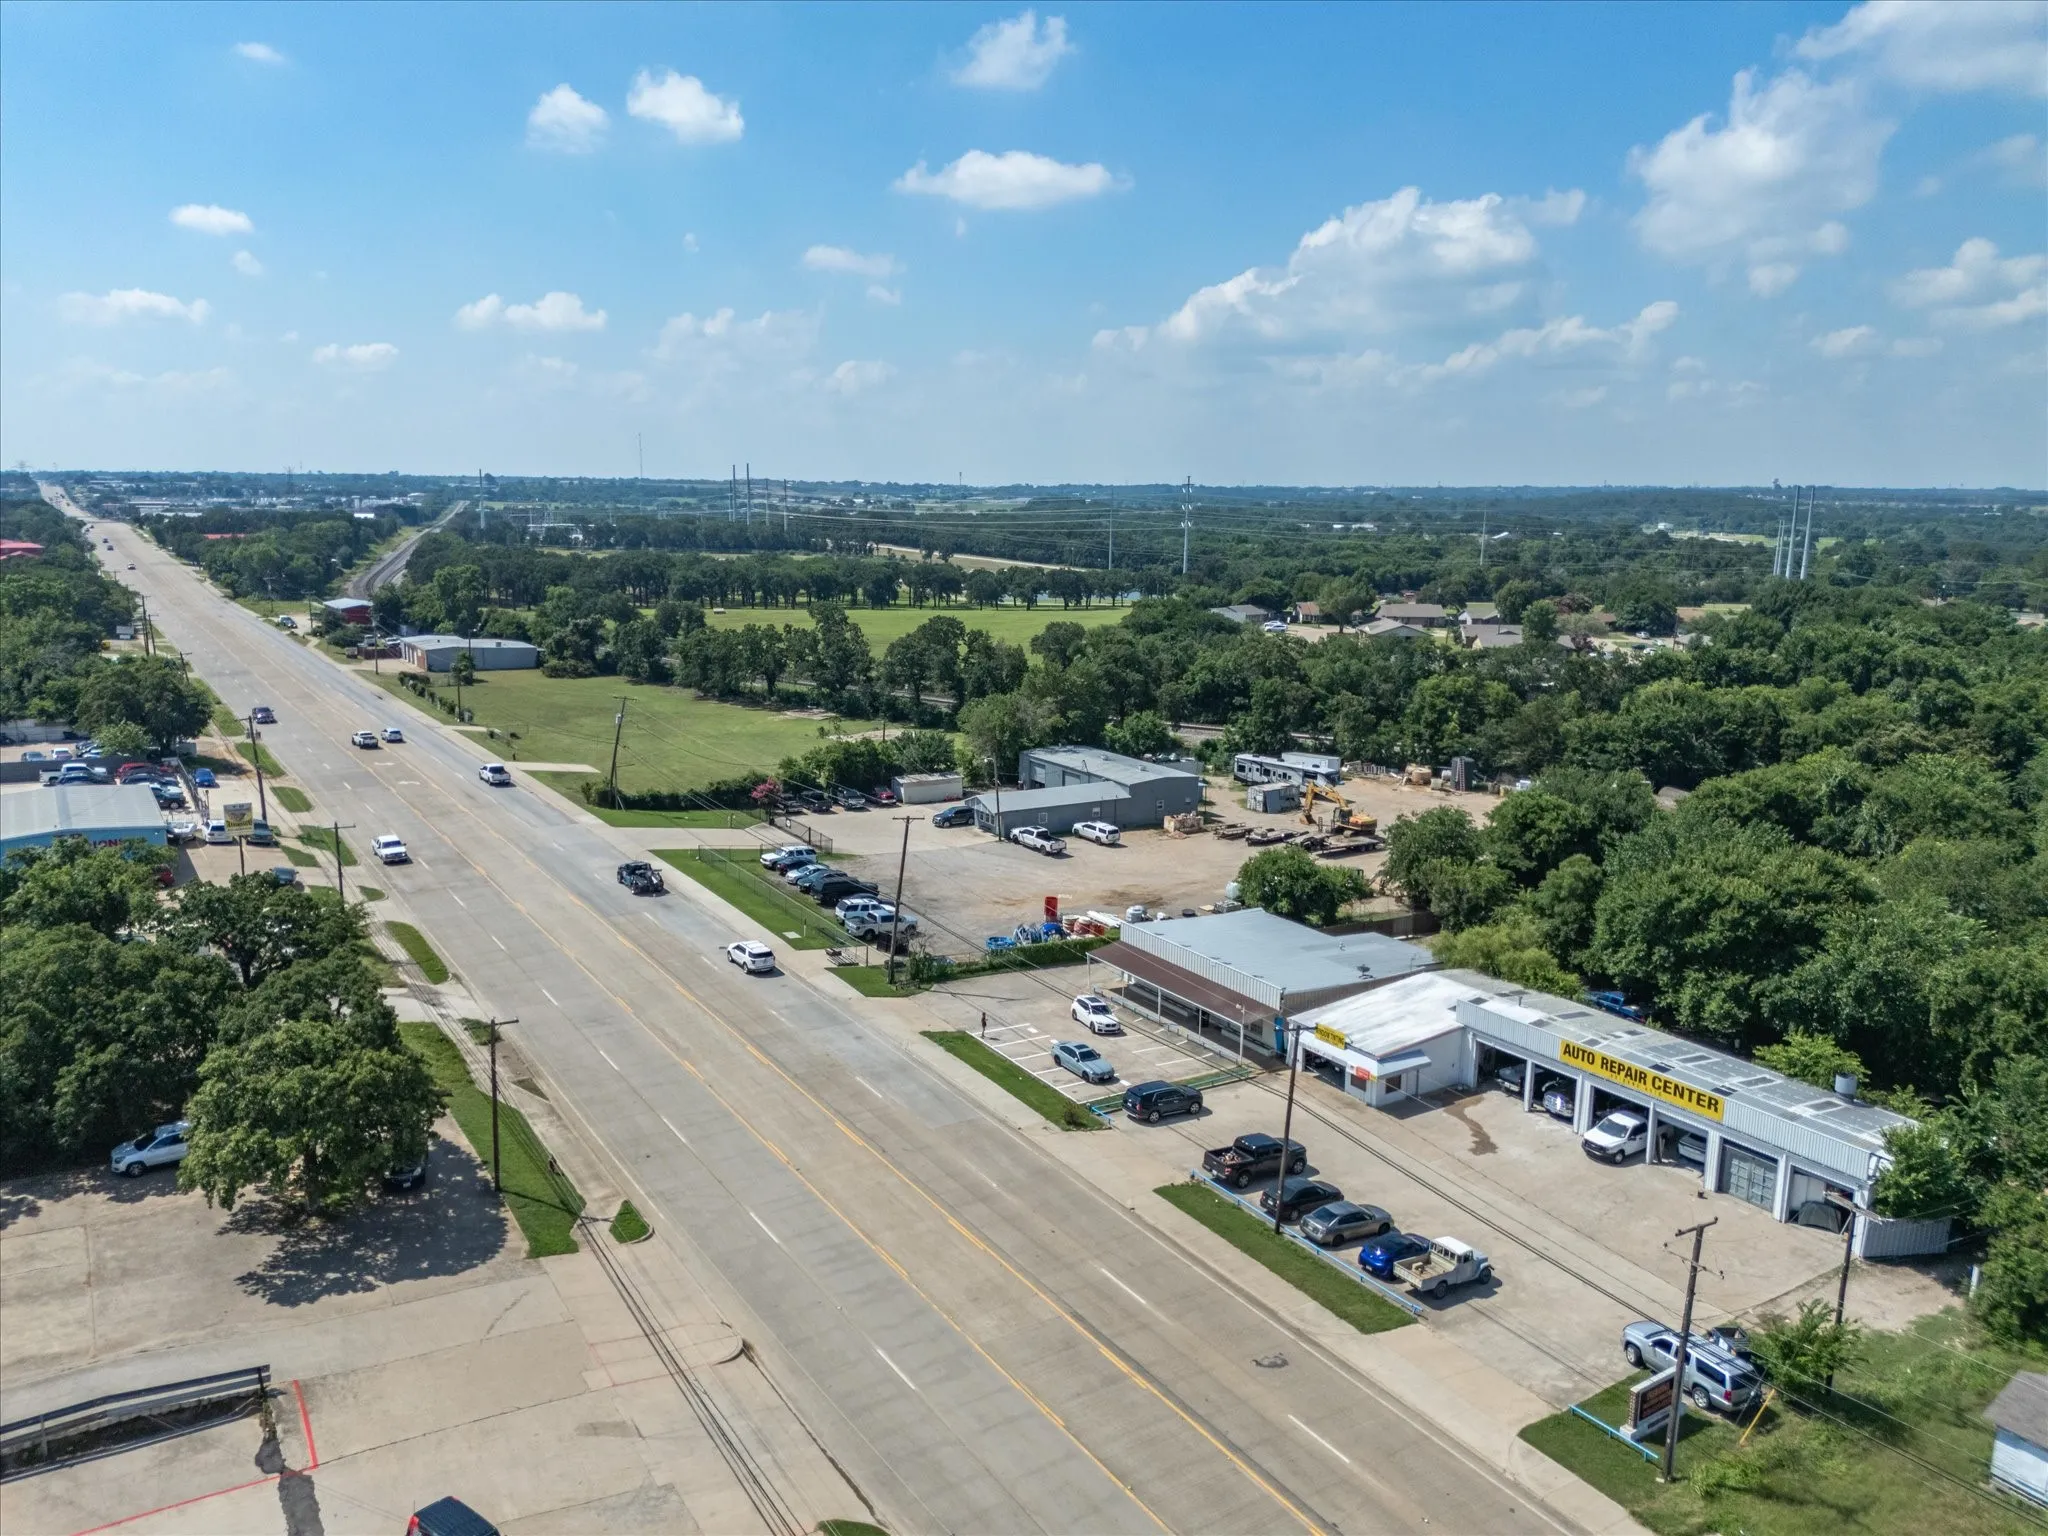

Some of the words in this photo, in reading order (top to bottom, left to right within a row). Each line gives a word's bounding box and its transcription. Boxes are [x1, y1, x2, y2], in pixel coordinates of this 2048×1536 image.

[1563, 1043, 1595, 1066] AUTO
[1600, 1056, 1647, 1086] REPAIR
[1651, 1075, 1719, 1114] CENTER
